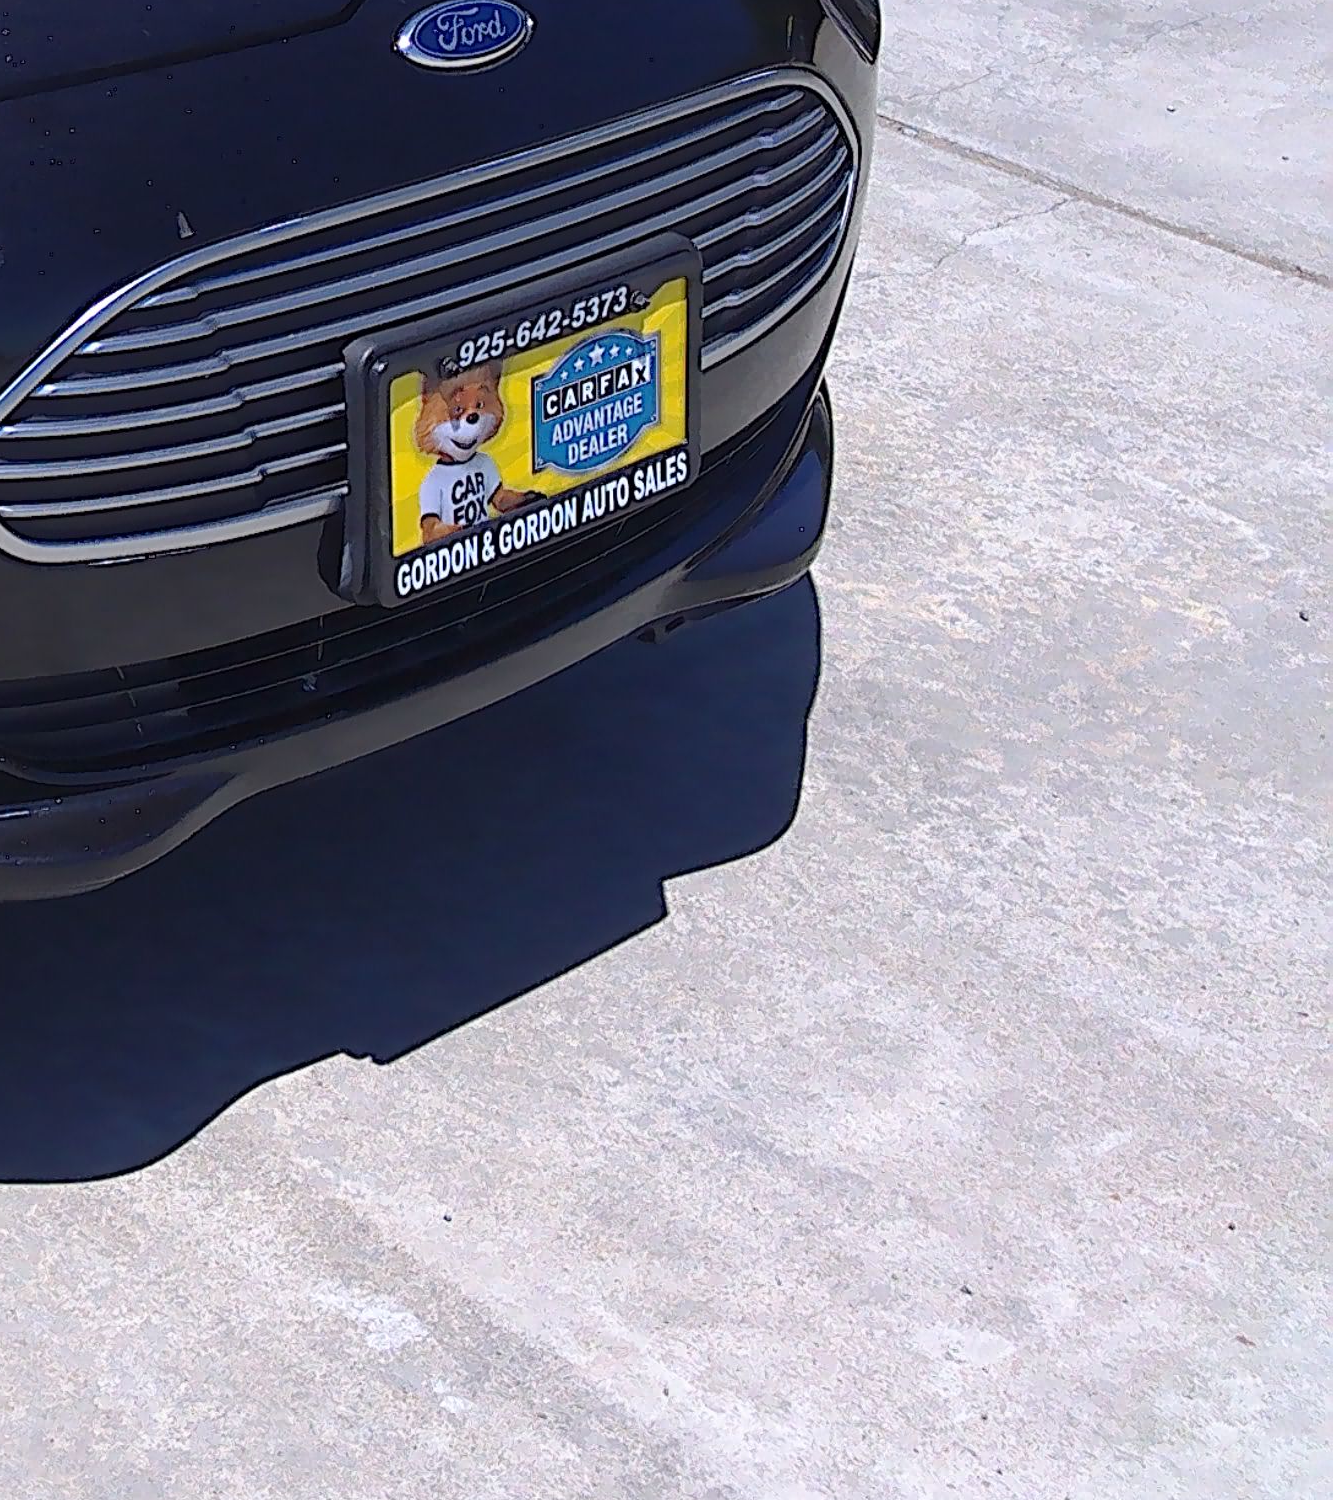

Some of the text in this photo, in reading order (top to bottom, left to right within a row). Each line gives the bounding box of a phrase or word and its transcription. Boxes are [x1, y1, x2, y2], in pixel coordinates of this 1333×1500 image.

[436, 6, 507, 51] Ford
[458, 285, 628, 368] 925-642-5373
[544, 355, 651, 417] CARFAX
[551, 393, 643, 446] ADVANTAGE
[568, 423, 629, 466] DEALER
[451, 471, 485, 503] CAR
[397, 452, 689, 597] GORDON & GORDON AUTO SALES
